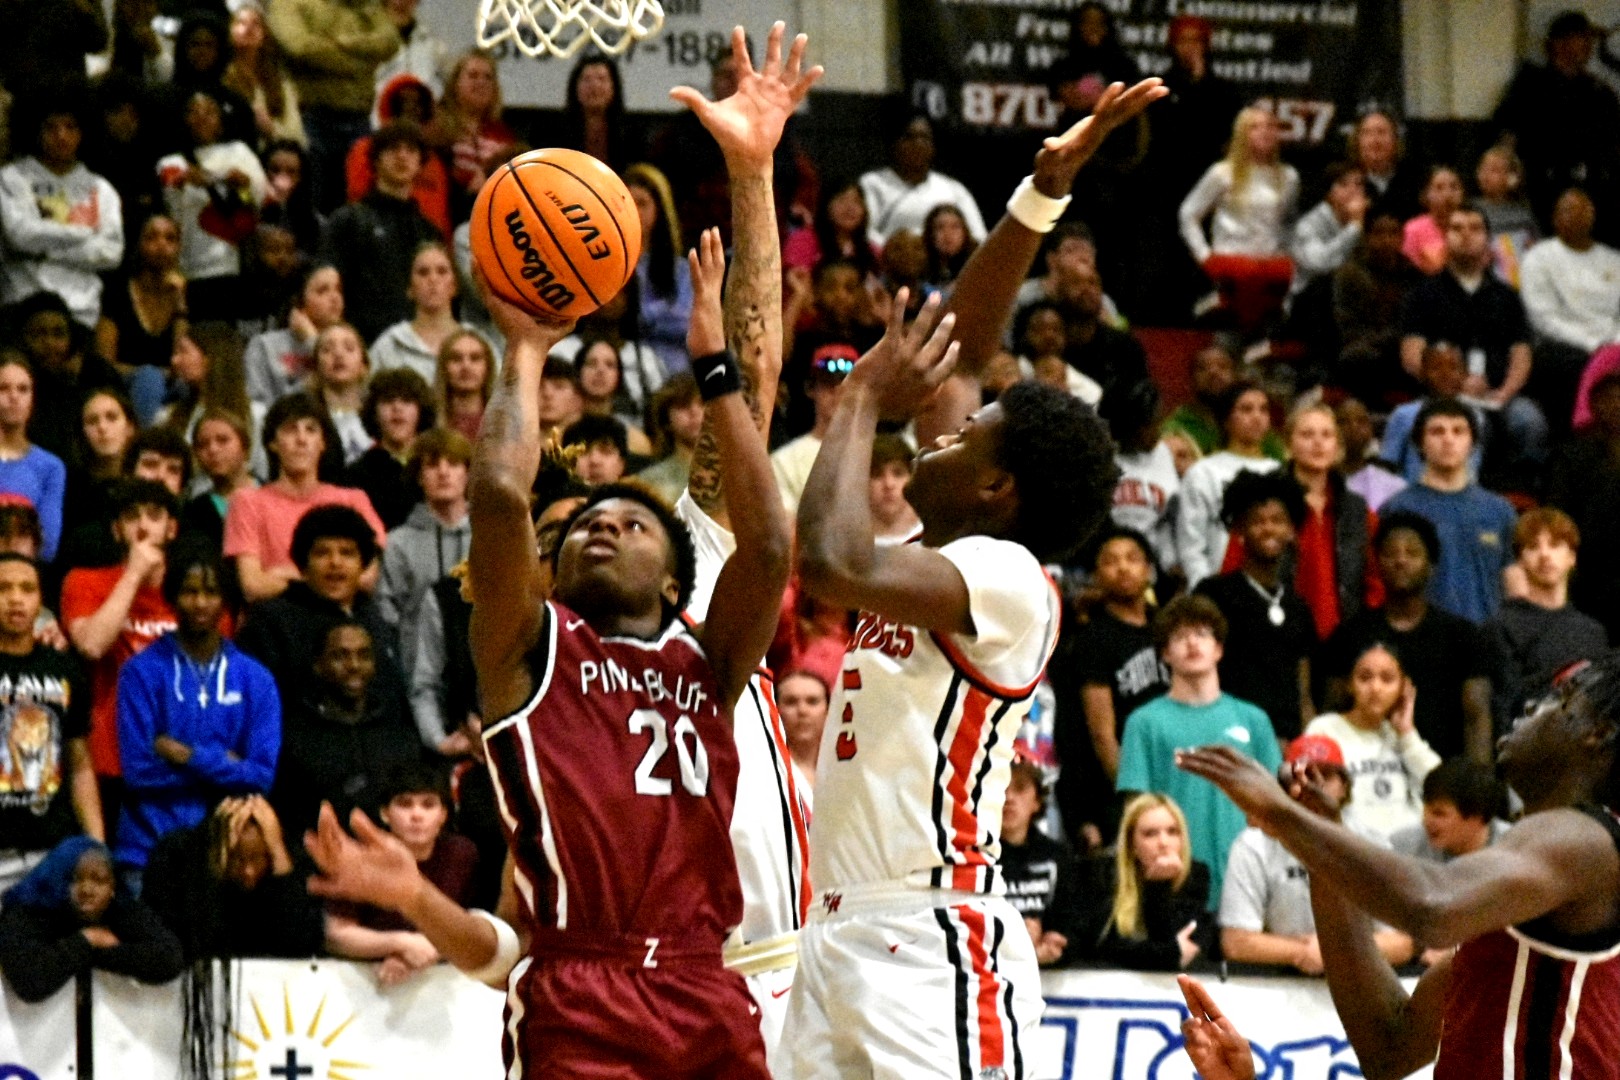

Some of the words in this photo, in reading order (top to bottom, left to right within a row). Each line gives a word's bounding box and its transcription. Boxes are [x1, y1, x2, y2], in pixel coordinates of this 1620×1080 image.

[504, 207, 576, 311] Wilson
[628, 708, 710, 798] 20
[642, 938, 660, 969] Z
